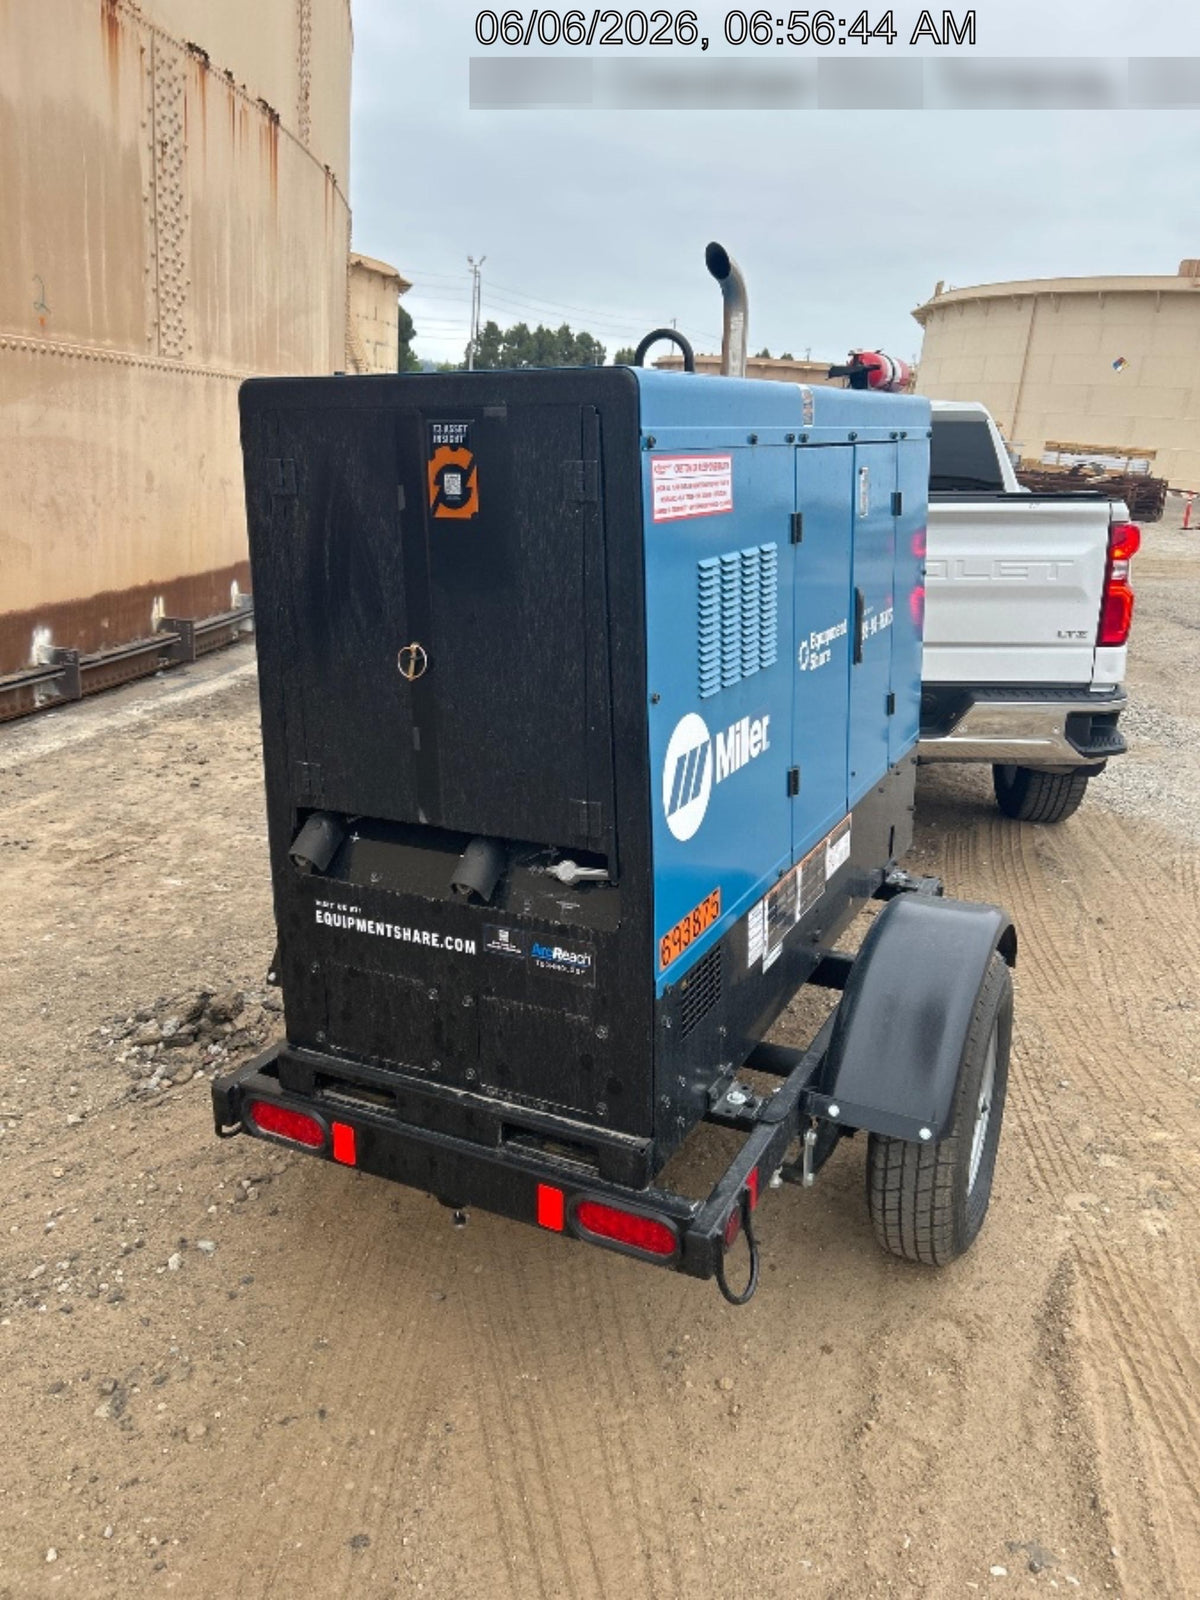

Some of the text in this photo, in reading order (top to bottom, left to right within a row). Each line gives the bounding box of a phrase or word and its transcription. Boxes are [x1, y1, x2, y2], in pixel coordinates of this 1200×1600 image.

[715, 714, 770, 784] Miller
[315, 909, 477, 956] EQUIPMENTSHARE.COM
[531, 942, 592, 966] ArcReach
[661, 889, 719, 966] 693875
